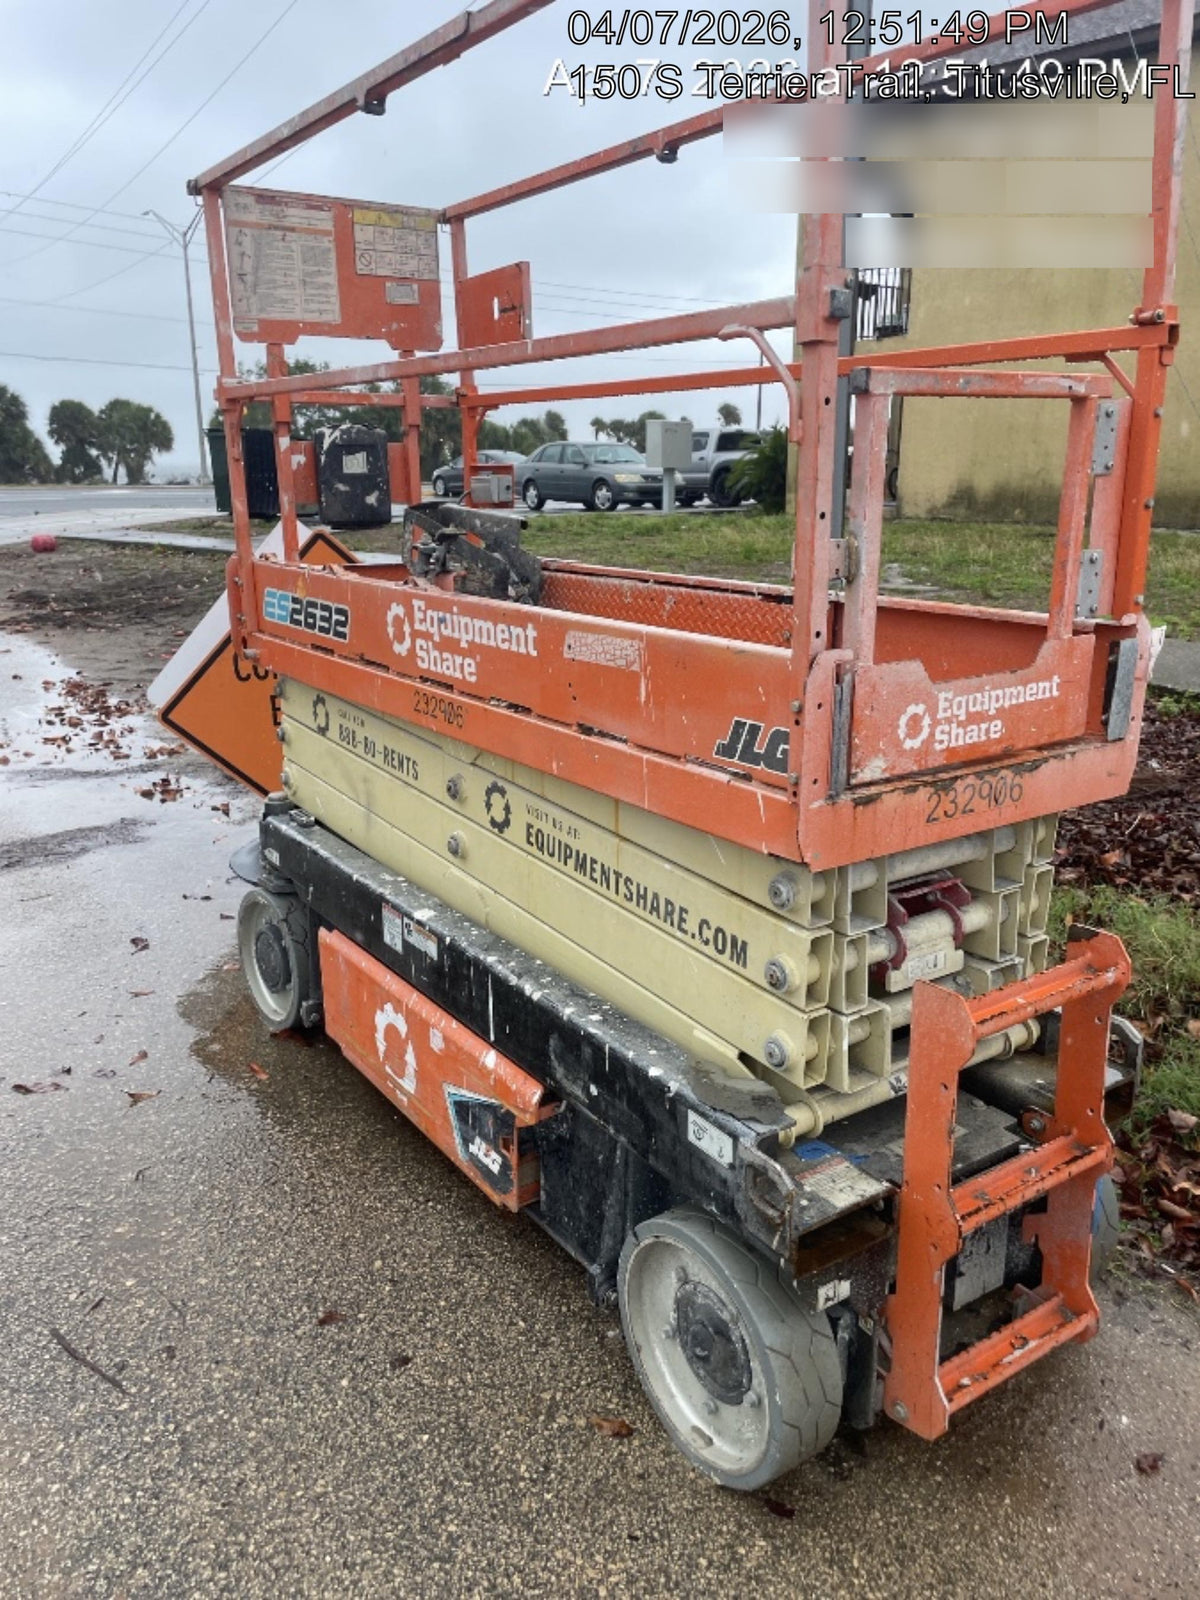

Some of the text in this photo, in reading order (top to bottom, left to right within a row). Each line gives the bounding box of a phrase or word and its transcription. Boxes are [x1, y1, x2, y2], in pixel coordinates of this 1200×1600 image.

[264, 588, 350, 643] ES2632
[412, 598, 538, 657] Equipment
[414, 638, 478, 683] Share
[413, 689, 464, 729] 232906
[936, 674, 1061, 719] Equipment
[713, 716, 791, 776] JLG
[934, 719, 1003, 752] Share
[926, 773, 1025, 824] 232906
[525, 821, 749, 969] EQUIPMENTSHARE.COM
